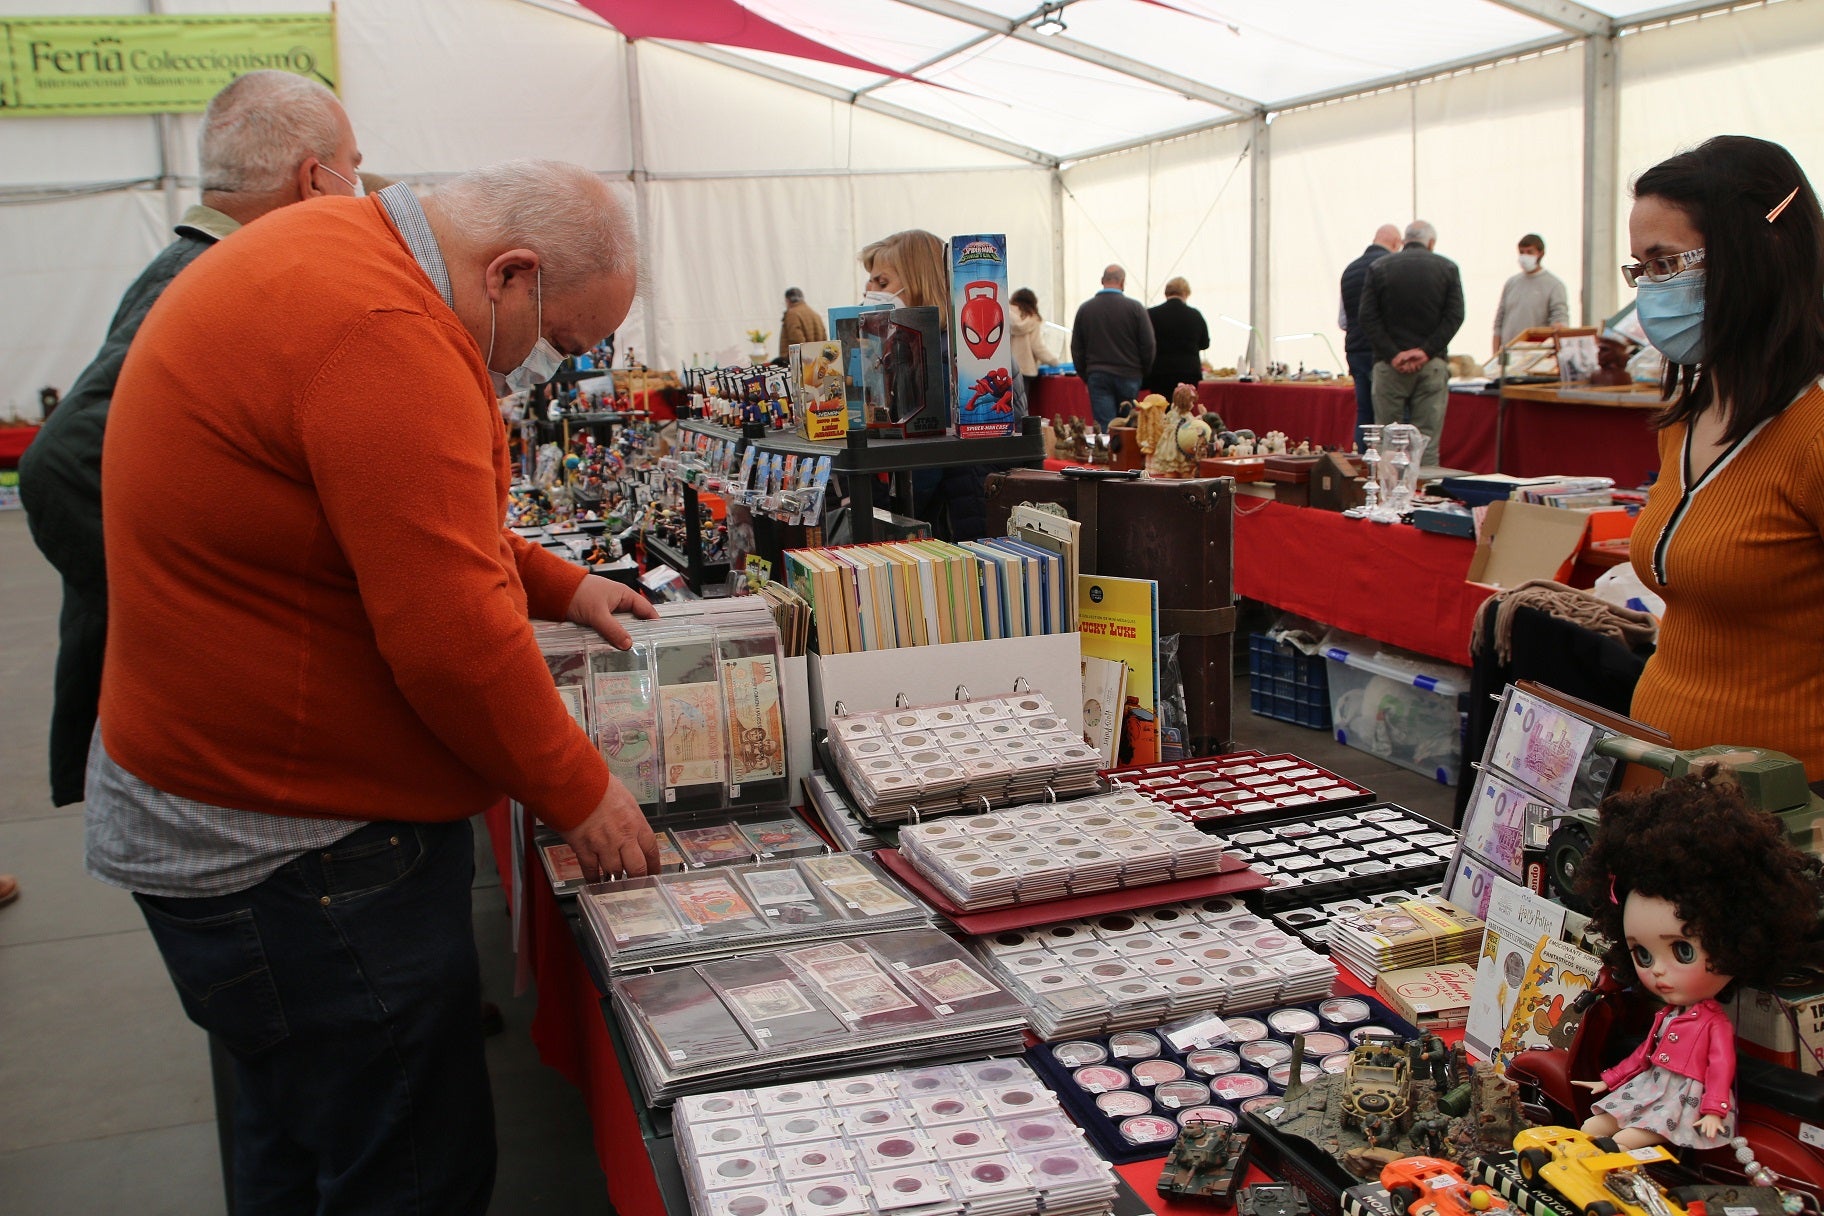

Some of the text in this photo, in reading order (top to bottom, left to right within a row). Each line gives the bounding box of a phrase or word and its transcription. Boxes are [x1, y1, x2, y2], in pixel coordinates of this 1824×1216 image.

[29, 37, 314, 73] Feria Coleccionismo
[1109, 622, 1137, 639] LUKE
[1530, 866, 1539, 893] endo
[1564, 953, 1575, 961] CON
